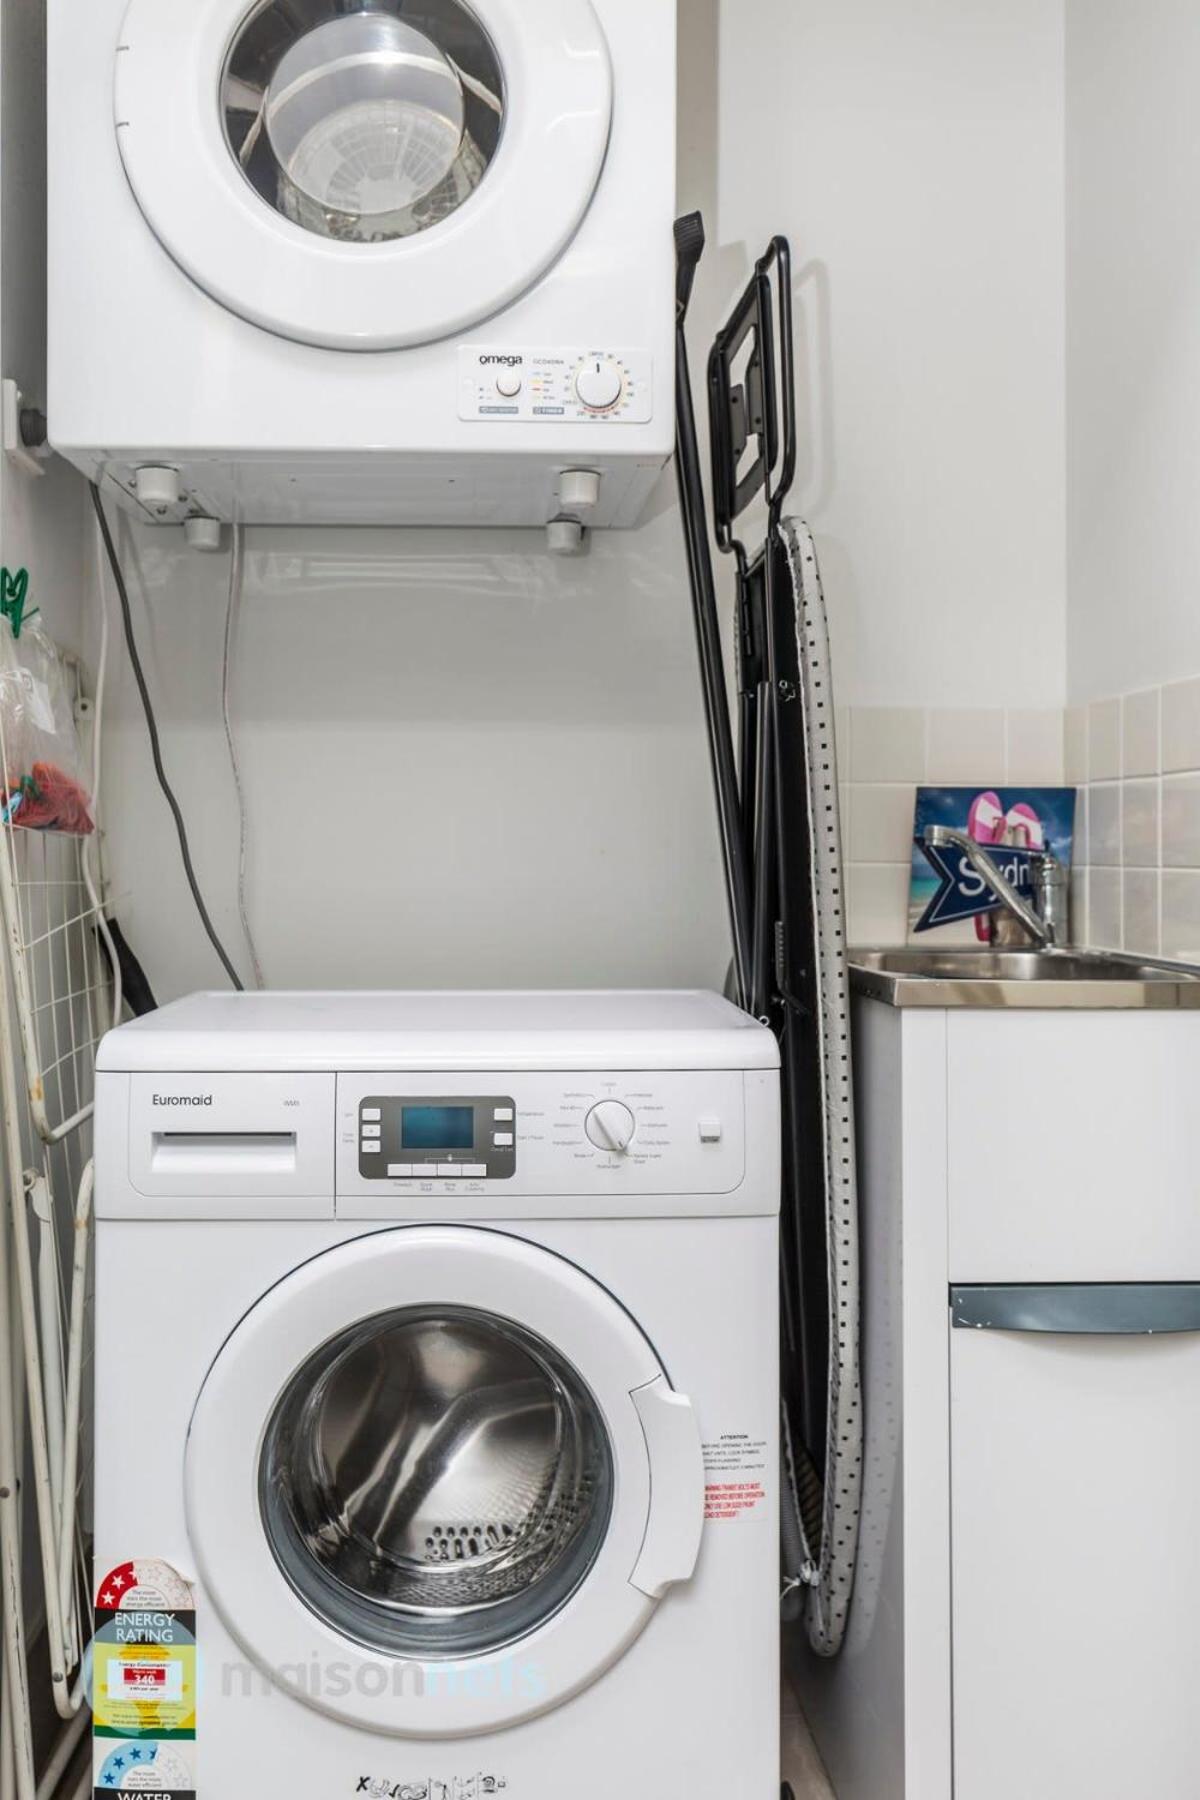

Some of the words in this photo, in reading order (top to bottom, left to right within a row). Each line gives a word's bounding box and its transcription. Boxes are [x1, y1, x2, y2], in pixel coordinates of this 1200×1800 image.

[479, 355, 523, 367] omega
[152, 1094, 213, 1106] Euromaid
[114, 1612, 175, 1627] ENERGY
[116, 1628, 173, 1642] RATING
